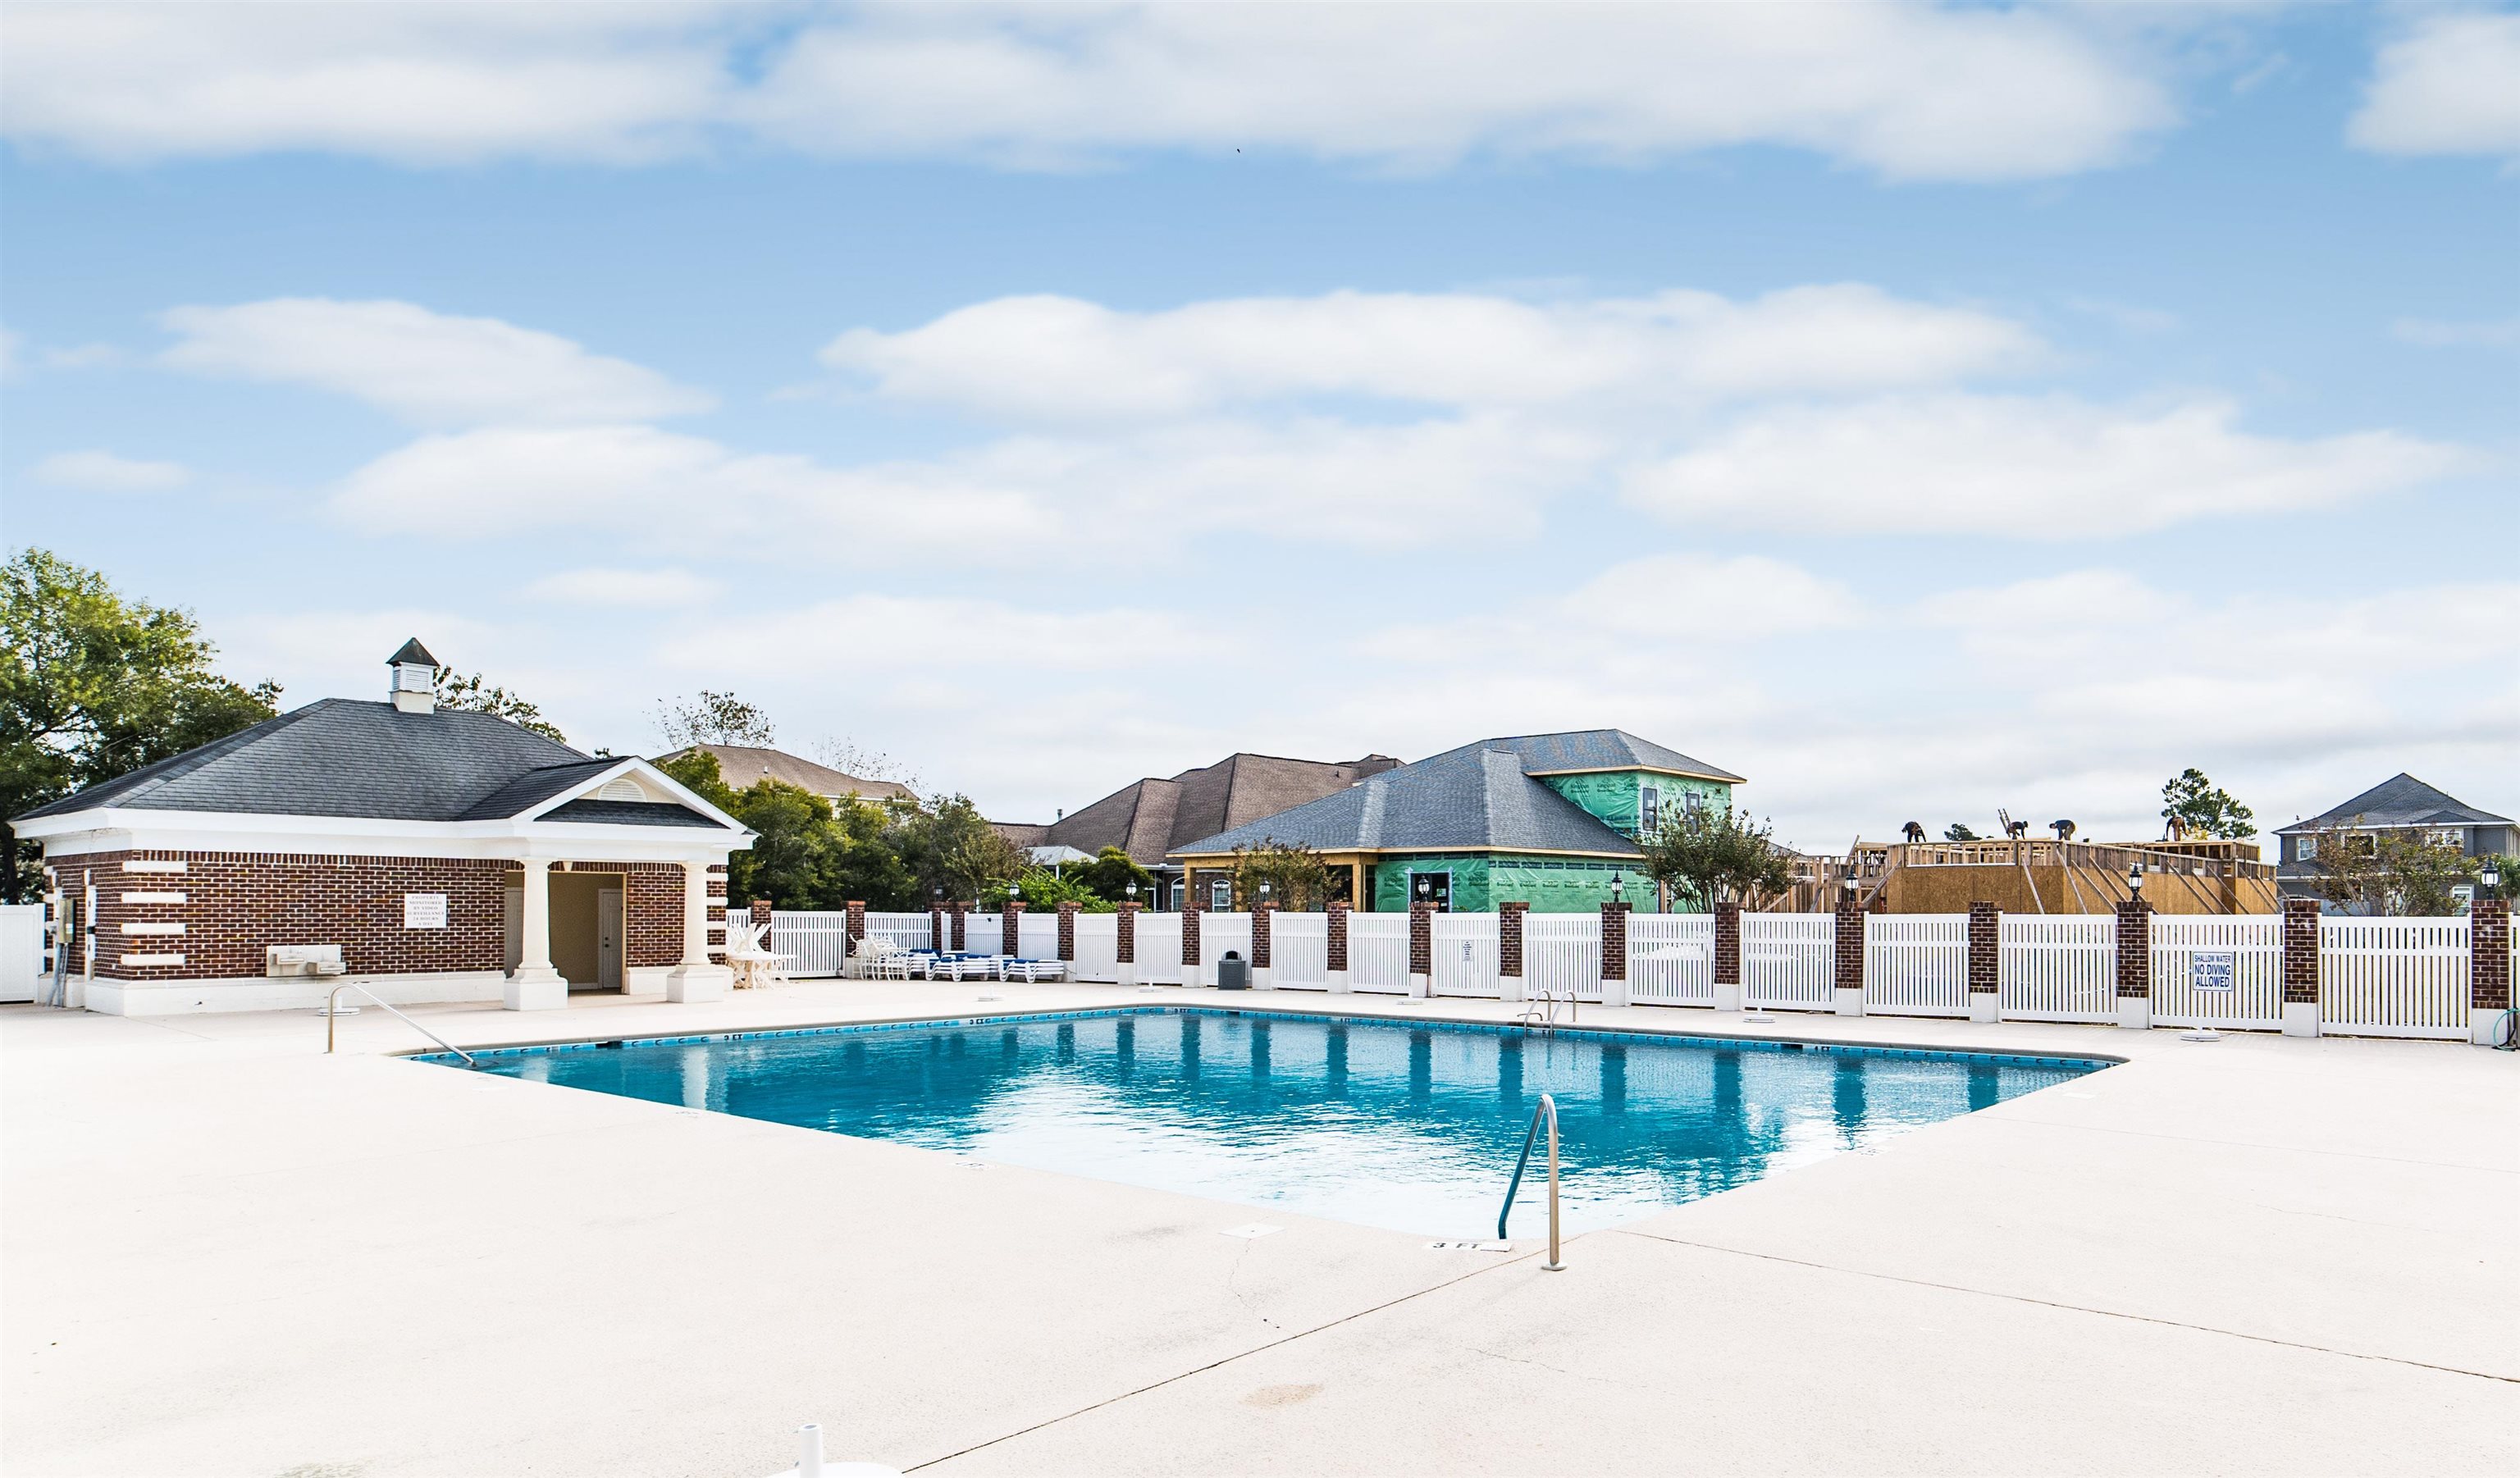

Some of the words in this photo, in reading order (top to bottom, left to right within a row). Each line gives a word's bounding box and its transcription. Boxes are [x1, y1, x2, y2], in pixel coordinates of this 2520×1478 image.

[2194, 955, 2214, 963] SHALLOW
[2216, 955, 2231, 963] WATER
[2194, 964, 2205, 975] NO
[2207, 964, 2230, 976] DIVING
[2195, 976, 2230, 988] ALLOWED
